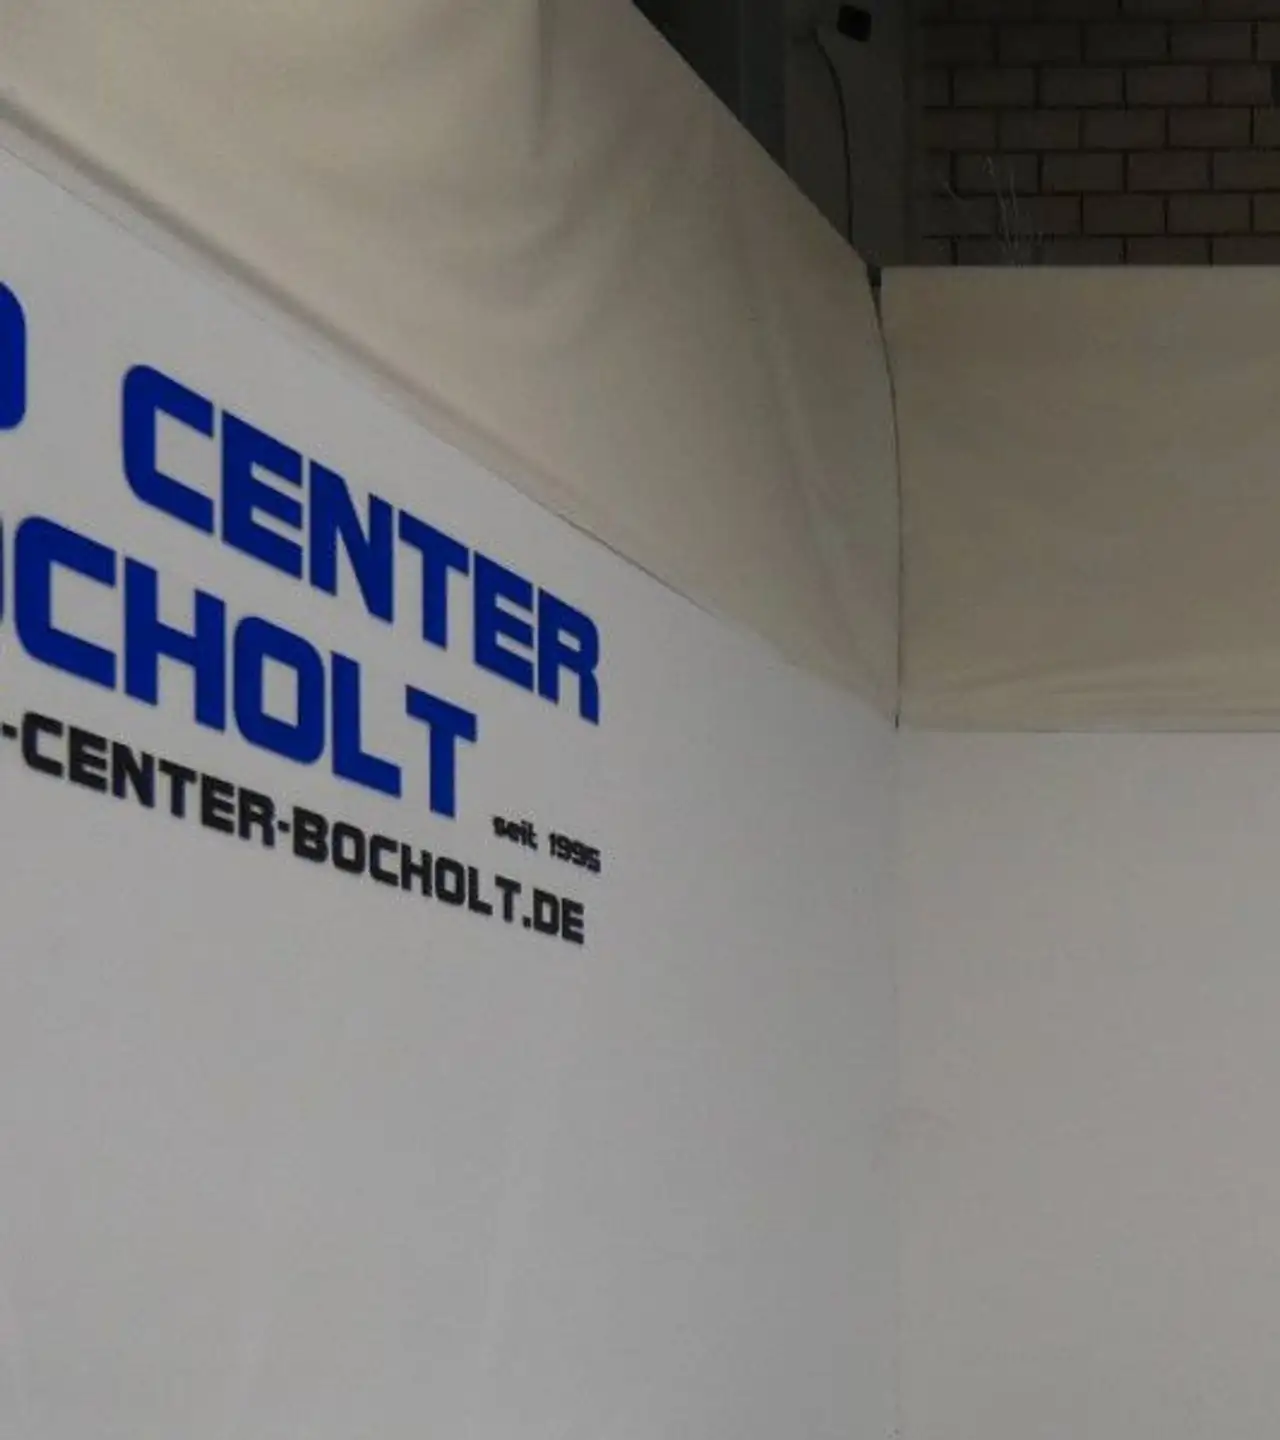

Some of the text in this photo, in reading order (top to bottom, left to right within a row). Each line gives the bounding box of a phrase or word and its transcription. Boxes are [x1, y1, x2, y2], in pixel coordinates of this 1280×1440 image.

[0, 514, 477, 819] CHOLT
[122, 363, 600, 725] CENTER
[492, 813, 602, 874] seit 1995
